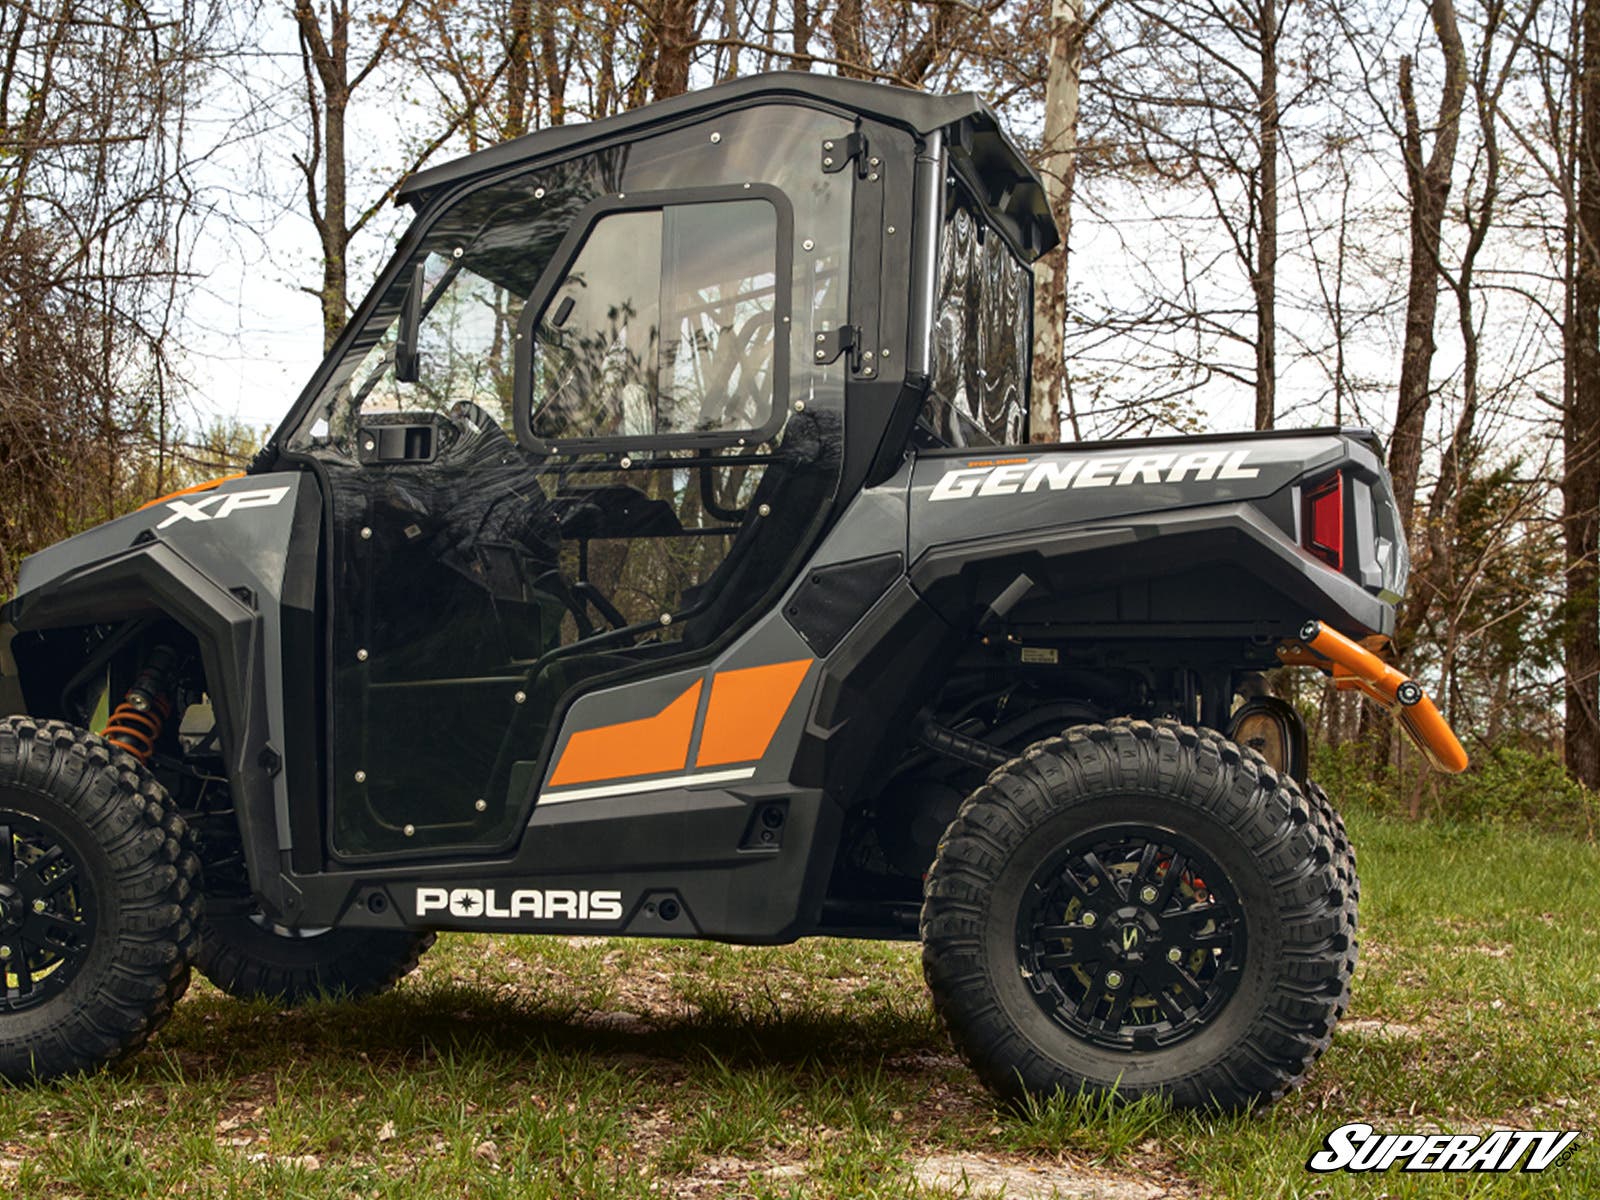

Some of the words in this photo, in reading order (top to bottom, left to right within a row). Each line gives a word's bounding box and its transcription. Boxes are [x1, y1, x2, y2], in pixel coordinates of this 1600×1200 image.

[928, 450, 1260, 501] GENERAL
[156, 486, 290, 529] XP
[416, 888, 623, 919] POLARIS
